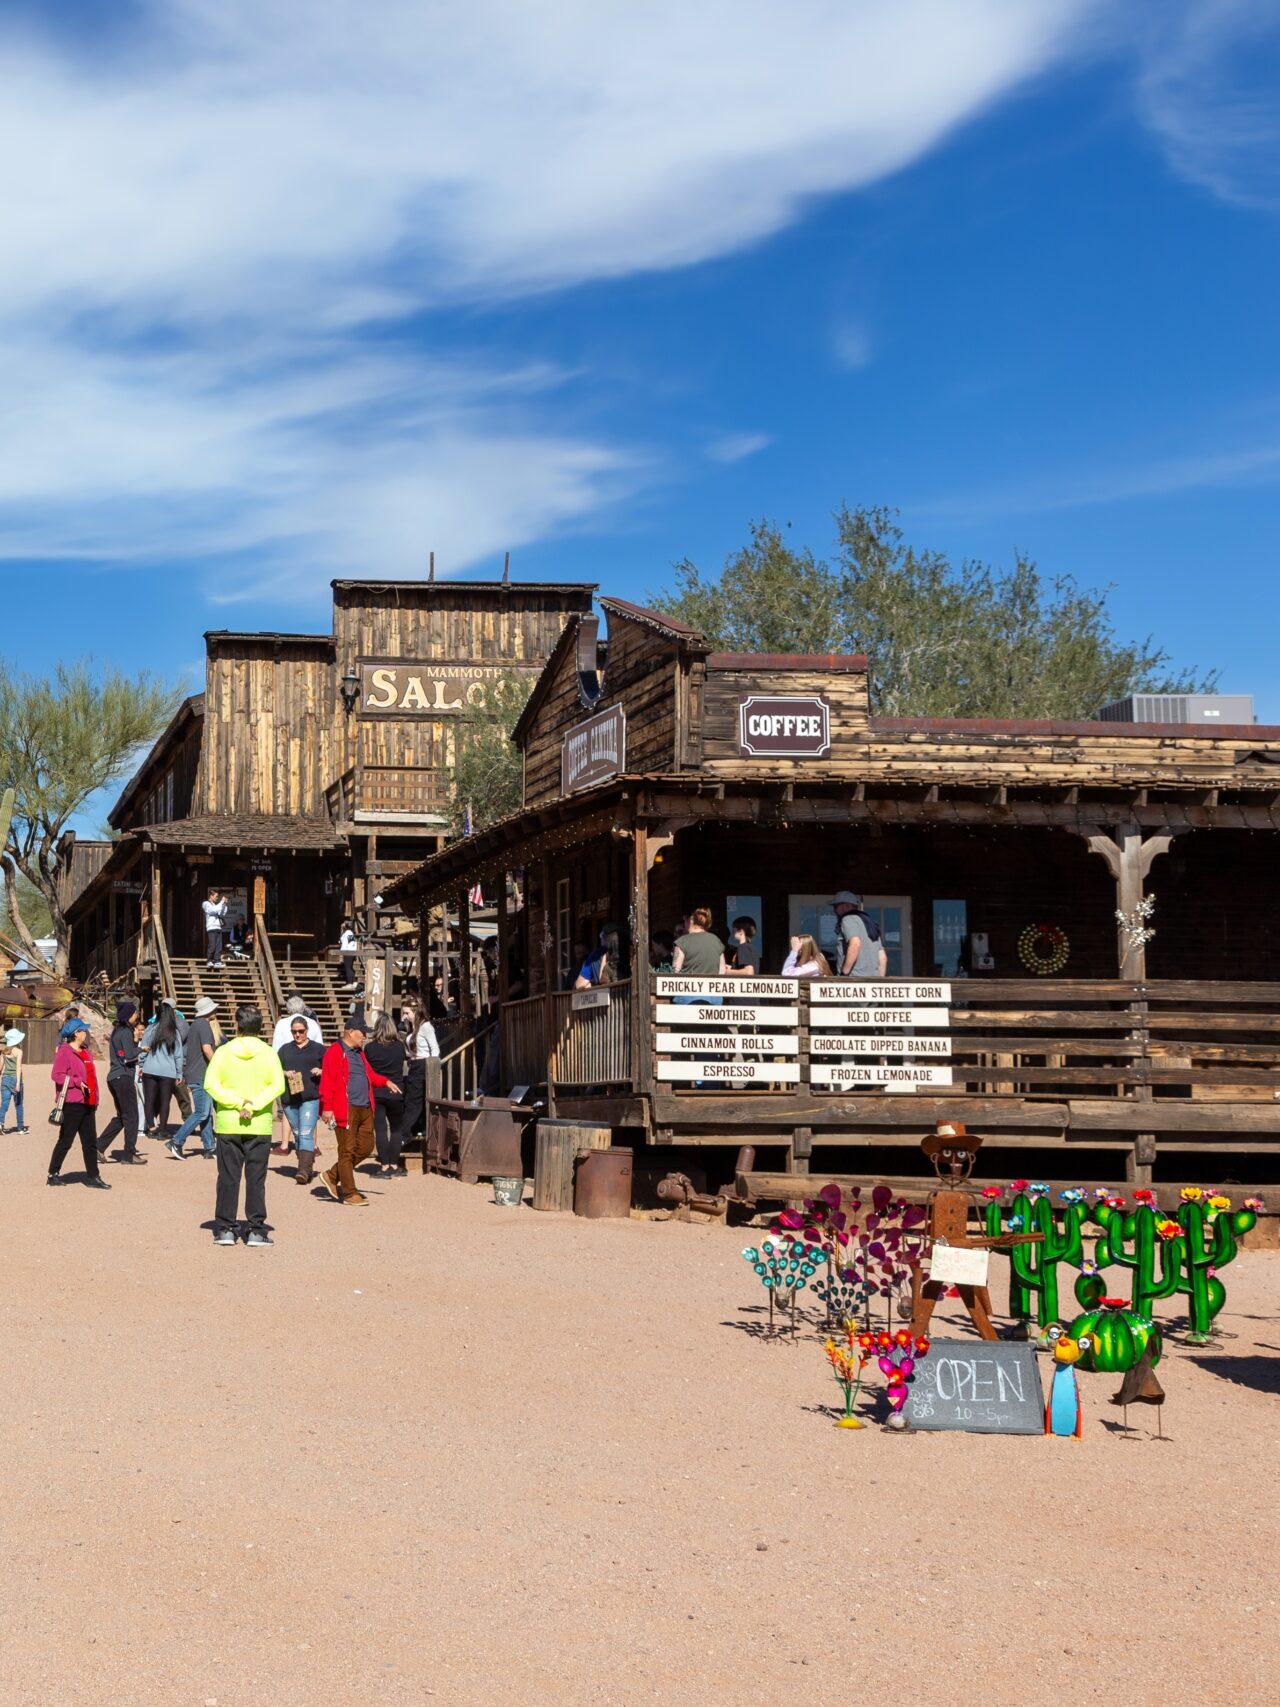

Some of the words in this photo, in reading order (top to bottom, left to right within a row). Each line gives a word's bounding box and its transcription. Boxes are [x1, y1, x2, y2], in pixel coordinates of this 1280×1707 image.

[427, 667, 503, 678] MAMMOTH
[748, 714, 821, 737] COFFEE
[568, 731, 588, 786] COFFEE
[661, 981, 703, 993] PRICKLY
[709, 982, 735, 993] PEAR
[740, 982, 794, 994] LEMONADE
[819, 987, 866, 998] MEXICAN
[871, 987, 911, 998] STREET
[915, 987, 942, 998] CORN
[699, 1009, 756, 1021] SMOOTHIES
[847, 1012, 869, 1022] ICED
[874, 1012, 912, 1022] COFFEE
[680, 1037, 736, 1049] CINNAMON
[741, 1039, 774, 1049] ROLLS
[814, 1039, 866, 1051] CHOCOLATE
[871, 1040, 904, 1051] DIPPED
[908, 1041, 948, 1052] BANANA
[703, 1065, 755, 1077] ESPRESSO
[831, 1069, 871, 1080] FROZEN
[877, 1070, 933, 1081] LEMONADE
[936, 1357, 1026, 1402] OPEN
